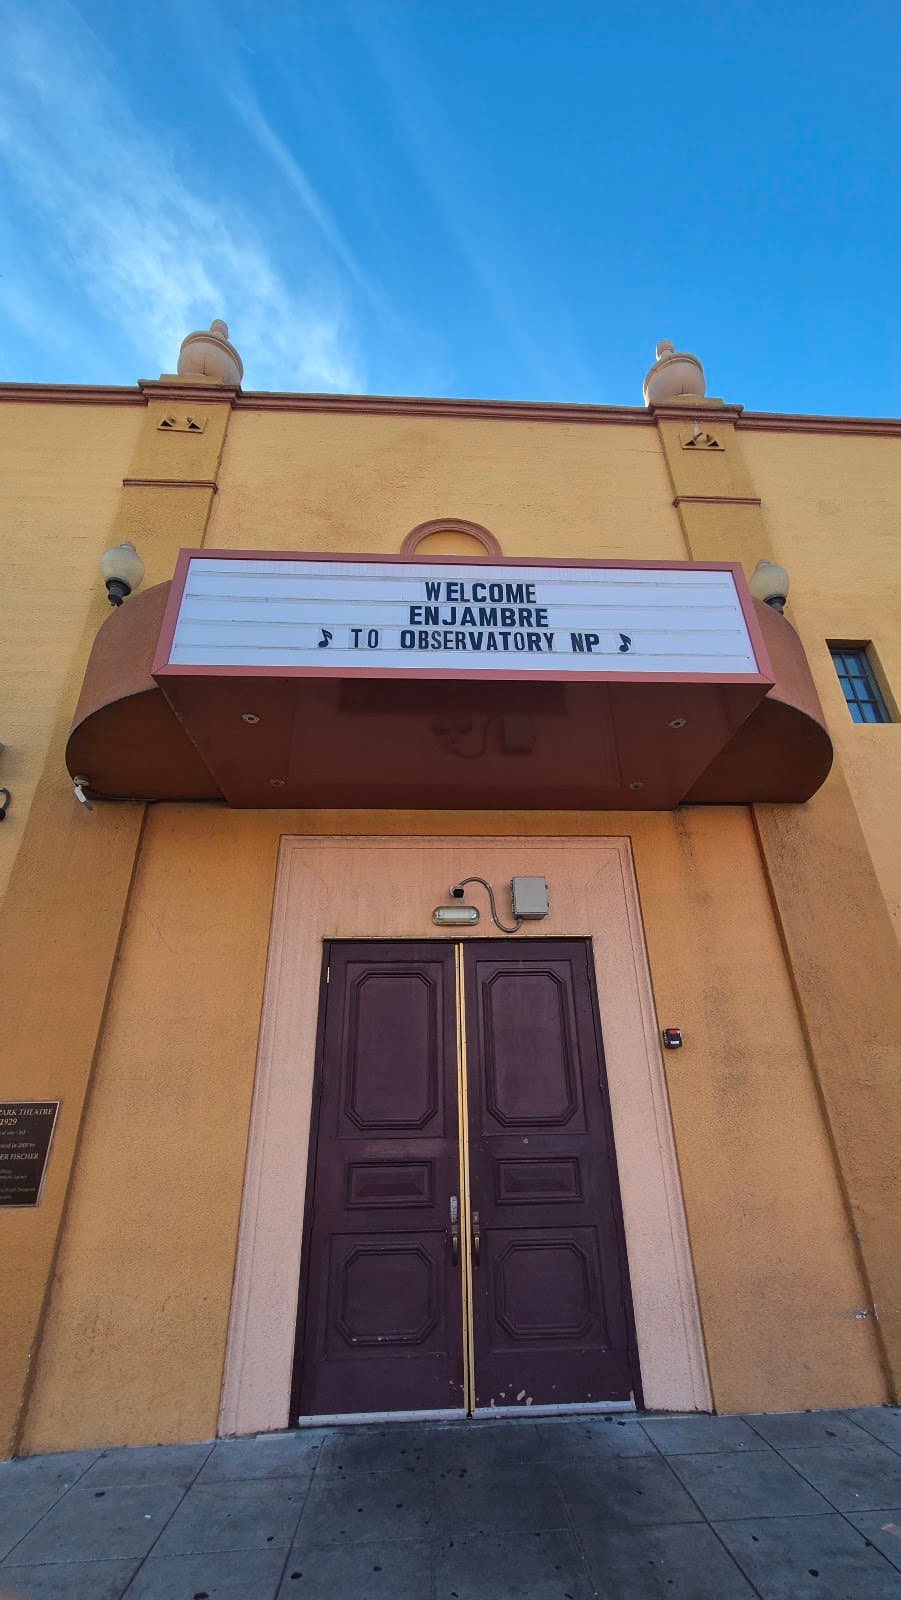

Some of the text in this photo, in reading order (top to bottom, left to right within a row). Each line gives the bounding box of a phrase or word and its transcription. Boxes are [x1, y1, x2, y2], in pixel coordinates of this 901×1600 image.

[425, 581, 537, 604] WELCOME
[409, 605, 549, 628] ENJAMBRE
[351, 628, 600, 653] TO OBSERVATORY NP
[18, 1107, 54, 1117] THEATRE
